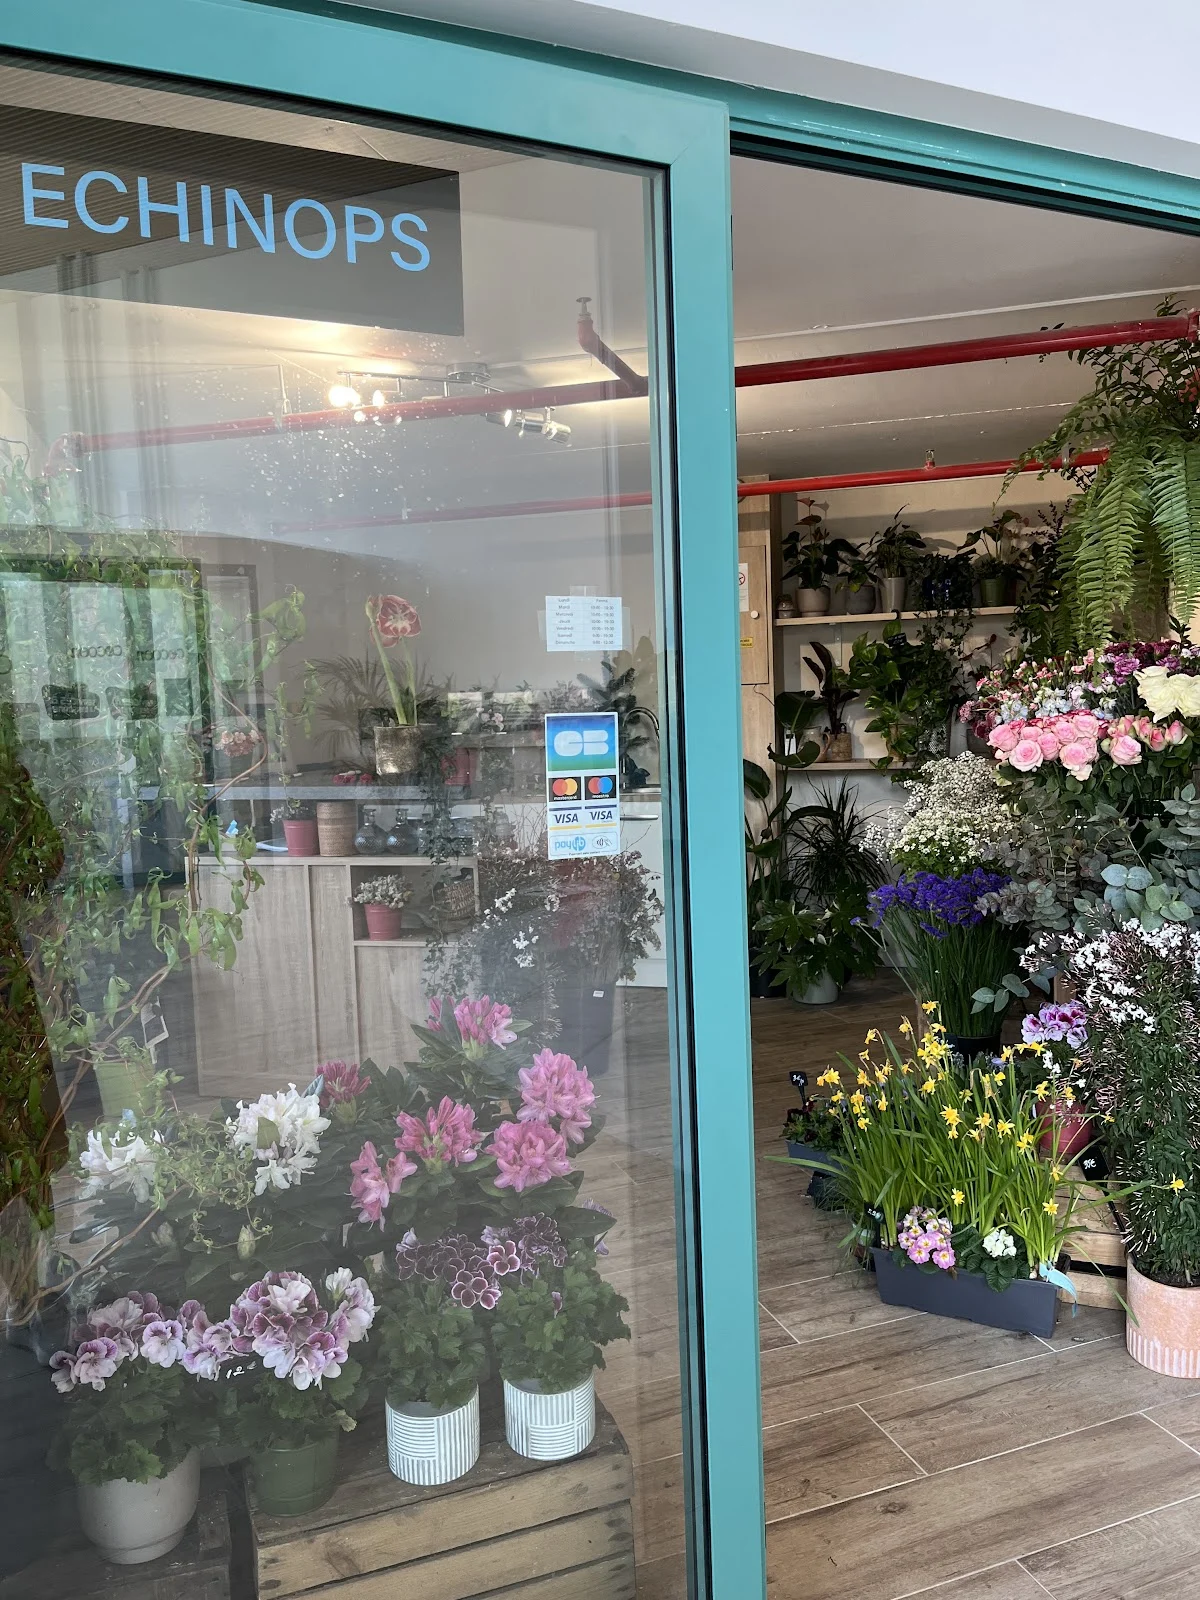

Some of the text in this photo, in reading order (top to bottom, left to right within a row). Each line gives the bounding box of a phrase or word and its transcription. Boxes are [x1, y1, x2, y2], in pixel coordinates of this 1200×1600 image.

[21, 162, 431, 272] ECHINOPS
[553, 730, 609, 757] CB
[553, 813, 579, 823] VISA
[589, 810, 613, 820] VISA
